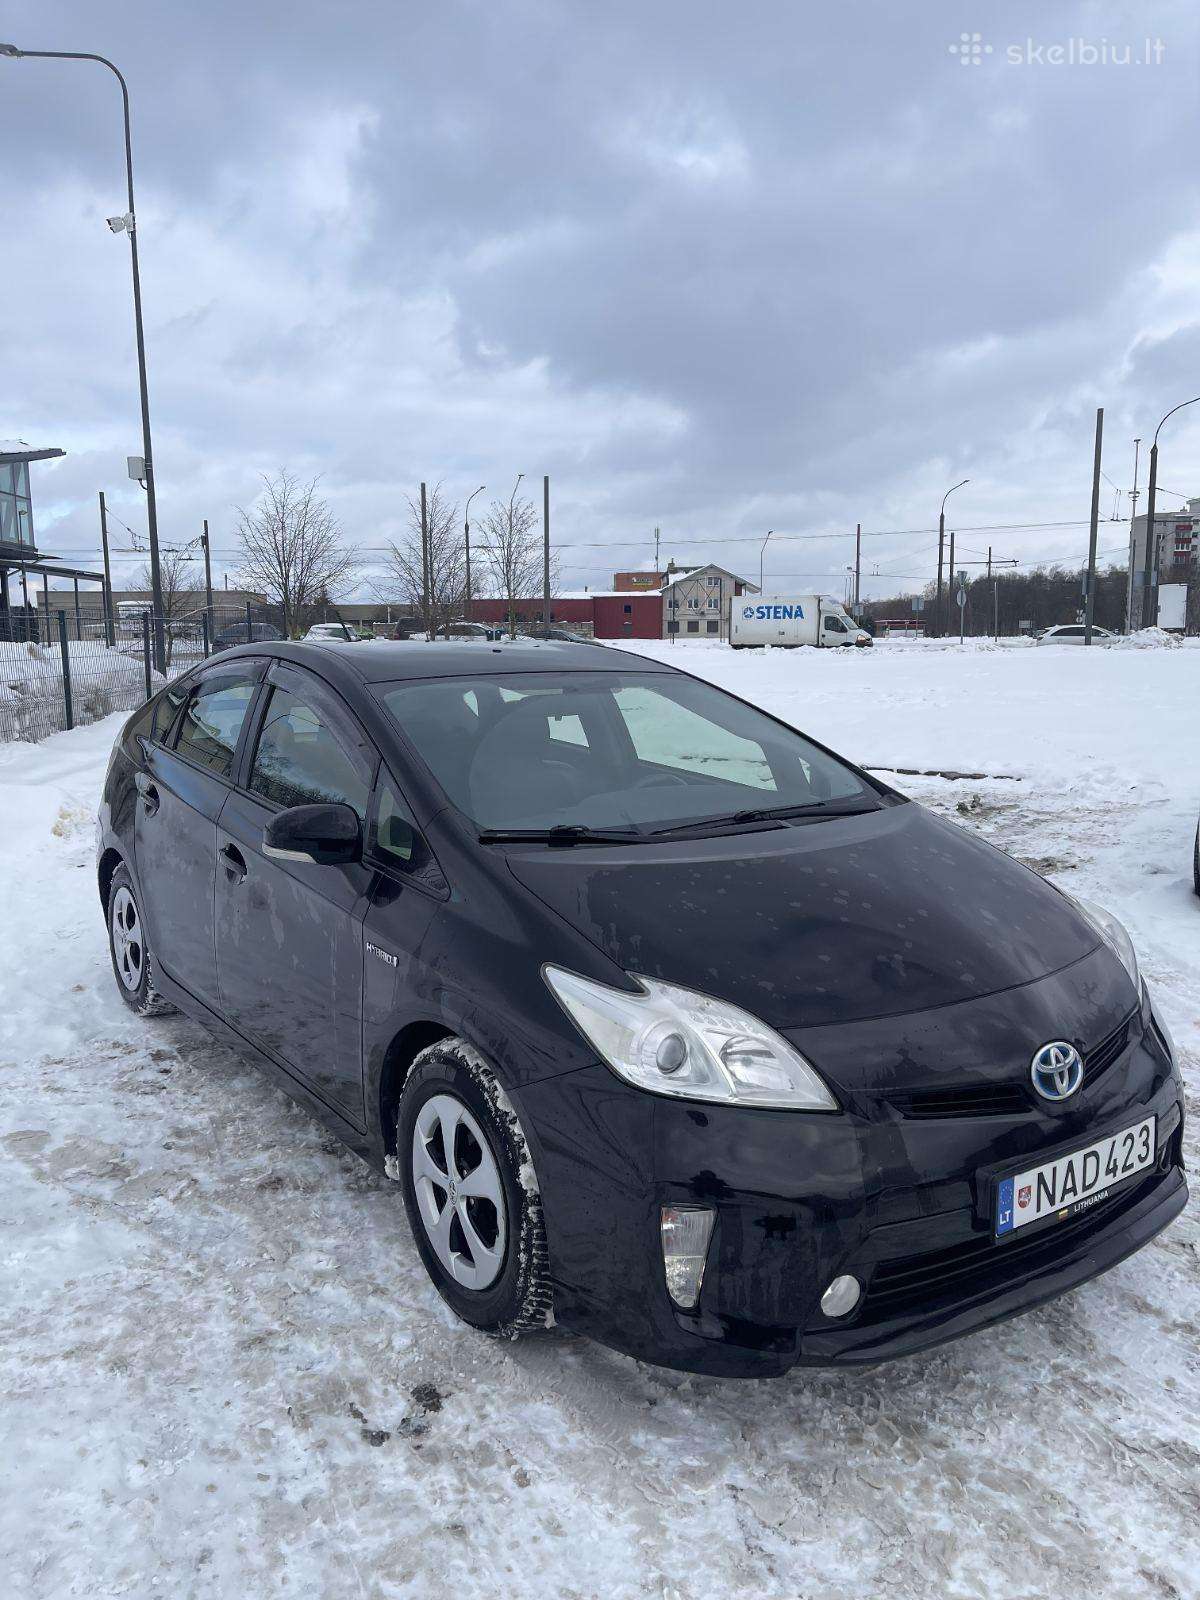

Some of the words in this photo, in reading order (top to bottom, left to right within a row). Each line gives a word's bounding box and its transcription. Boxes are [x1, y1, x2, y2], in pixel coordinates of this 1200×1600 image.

[756, 605, 805, 620] STENA
[1074, 1190, 1109, 1213] LITHUANIA
[1000, 1209, 1011, 1224] LT
